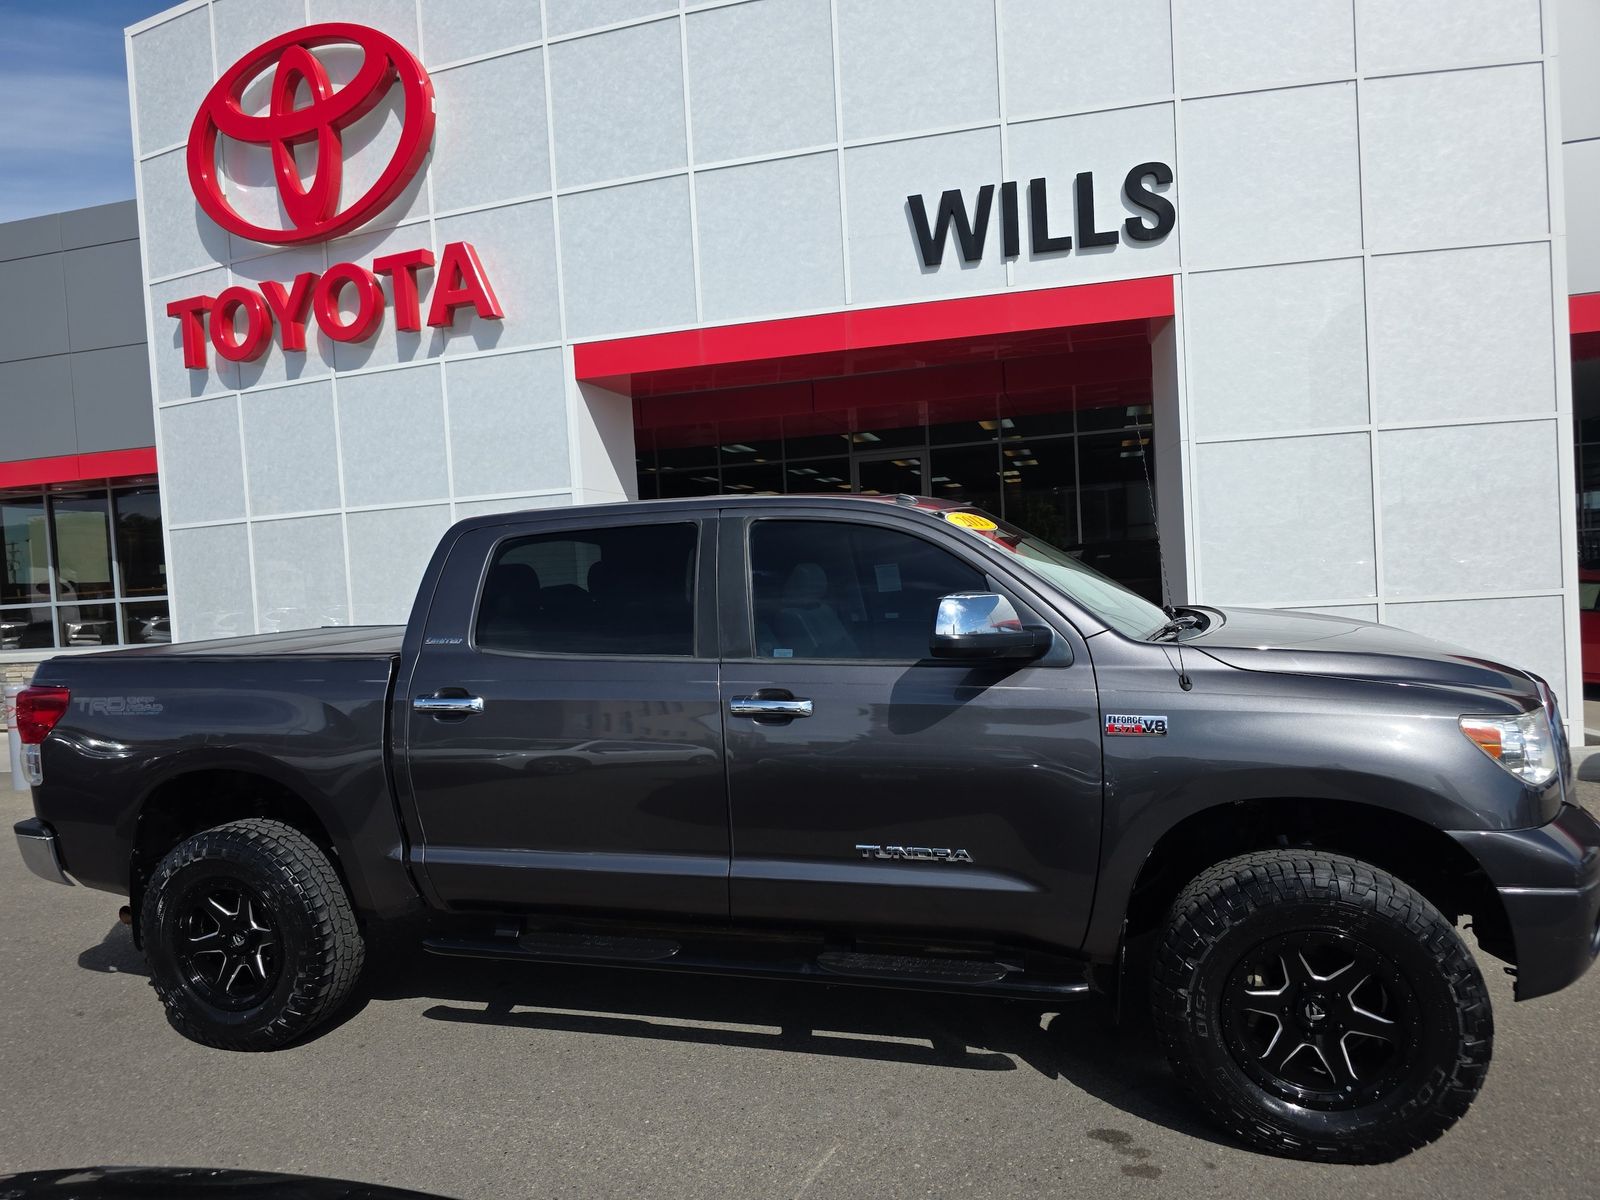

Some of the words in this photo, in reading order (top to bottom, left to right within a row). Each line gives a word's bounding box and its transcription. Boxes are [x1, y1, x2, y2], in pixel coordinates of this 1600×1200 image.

[907, 161, 1176, 266] WILLS
[167, 241, 505, 370] TOYOTA
[73, 696, 126, 716] TRD
[1143, 719, 1166, 733] V8
[855, 844, 974, 863] TUNDRA
